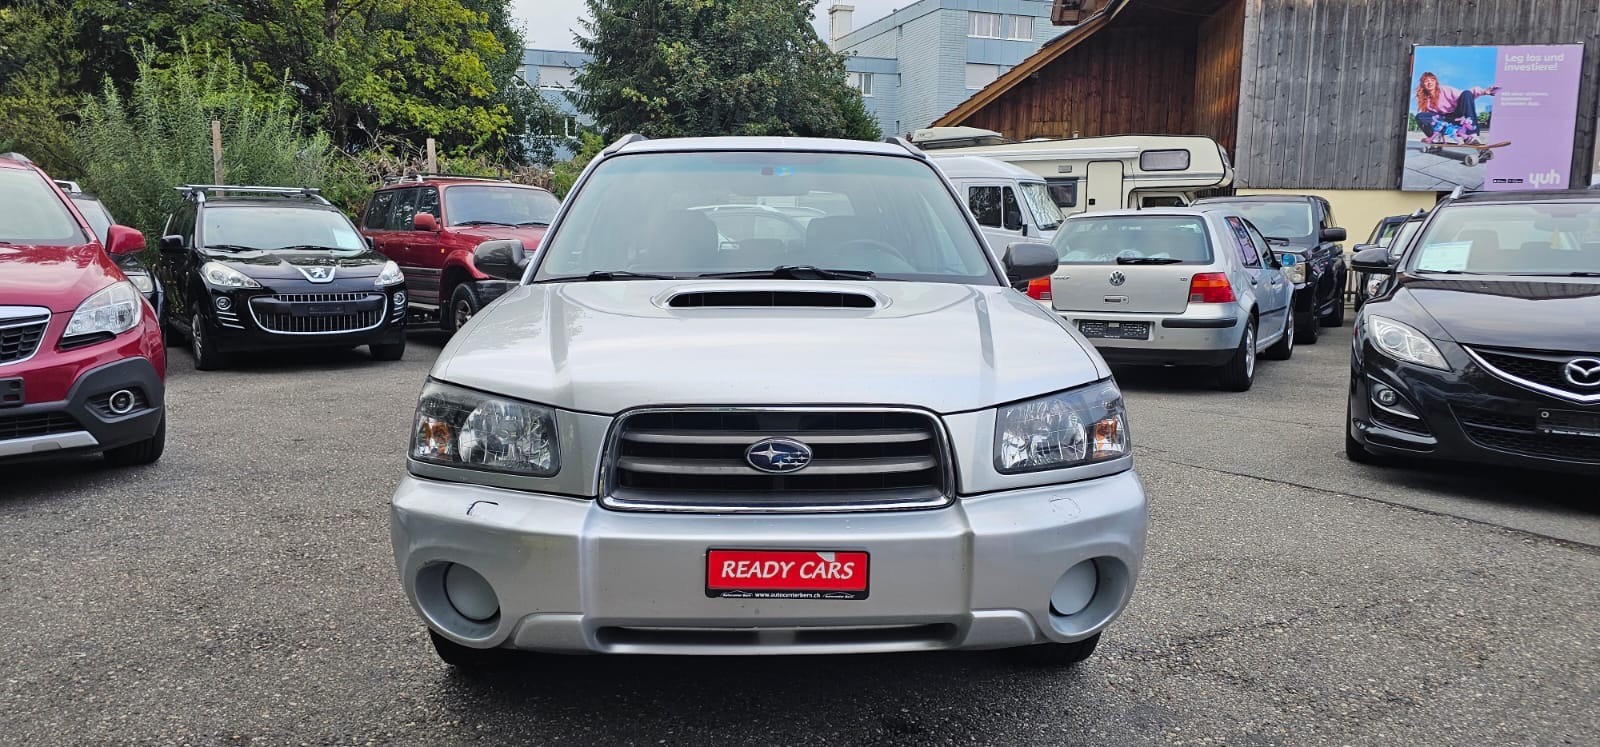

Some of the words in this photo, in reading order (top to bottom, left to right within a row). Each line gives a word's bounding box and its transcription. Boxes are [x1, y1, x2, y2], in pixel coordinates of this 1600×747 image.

[1504, 53, 1524, 64] Leg
[1526, 53, 1542, 62] los
[1543, 52, 1565, 62] und
[1504, 62, 1558, 71] investiere!
[1529, 169, 1561, 188] yuh
[721, 560, 795, 578] READY
[799, 561, 855, 579] CARS
